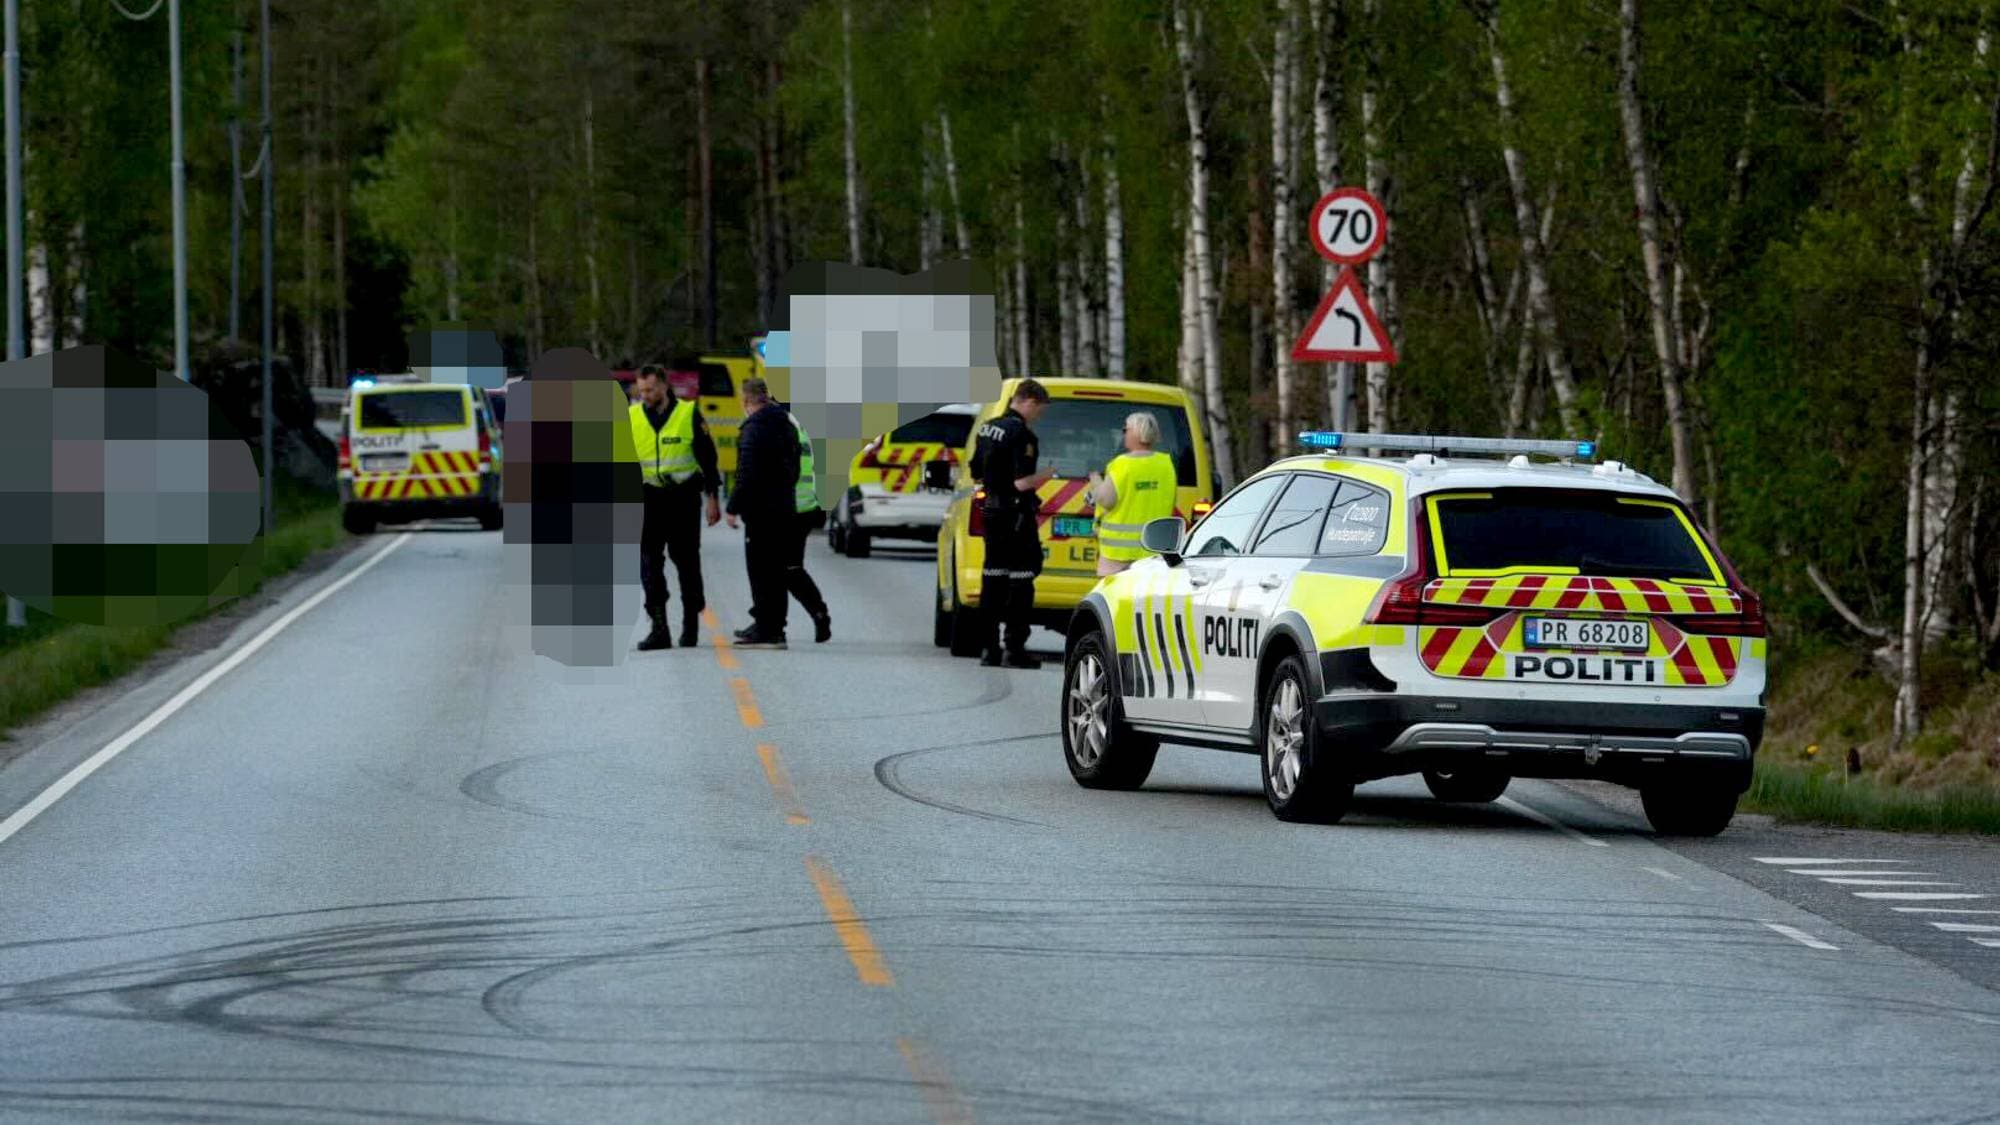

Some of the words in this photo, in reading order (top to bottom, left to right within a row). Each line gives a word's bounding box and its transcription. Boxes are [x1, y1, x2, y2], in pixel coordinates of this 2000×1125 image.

[1328, 209, 1372, 244] 70
[1069, 546, 1099, 561] LE
[1205, 615, 1260, 659] POLITI
[1542, 621, 1568, 641] PR
[1578, 623, 1644, 645] 68208
[1514, 655, 1655, 682] POLITI
